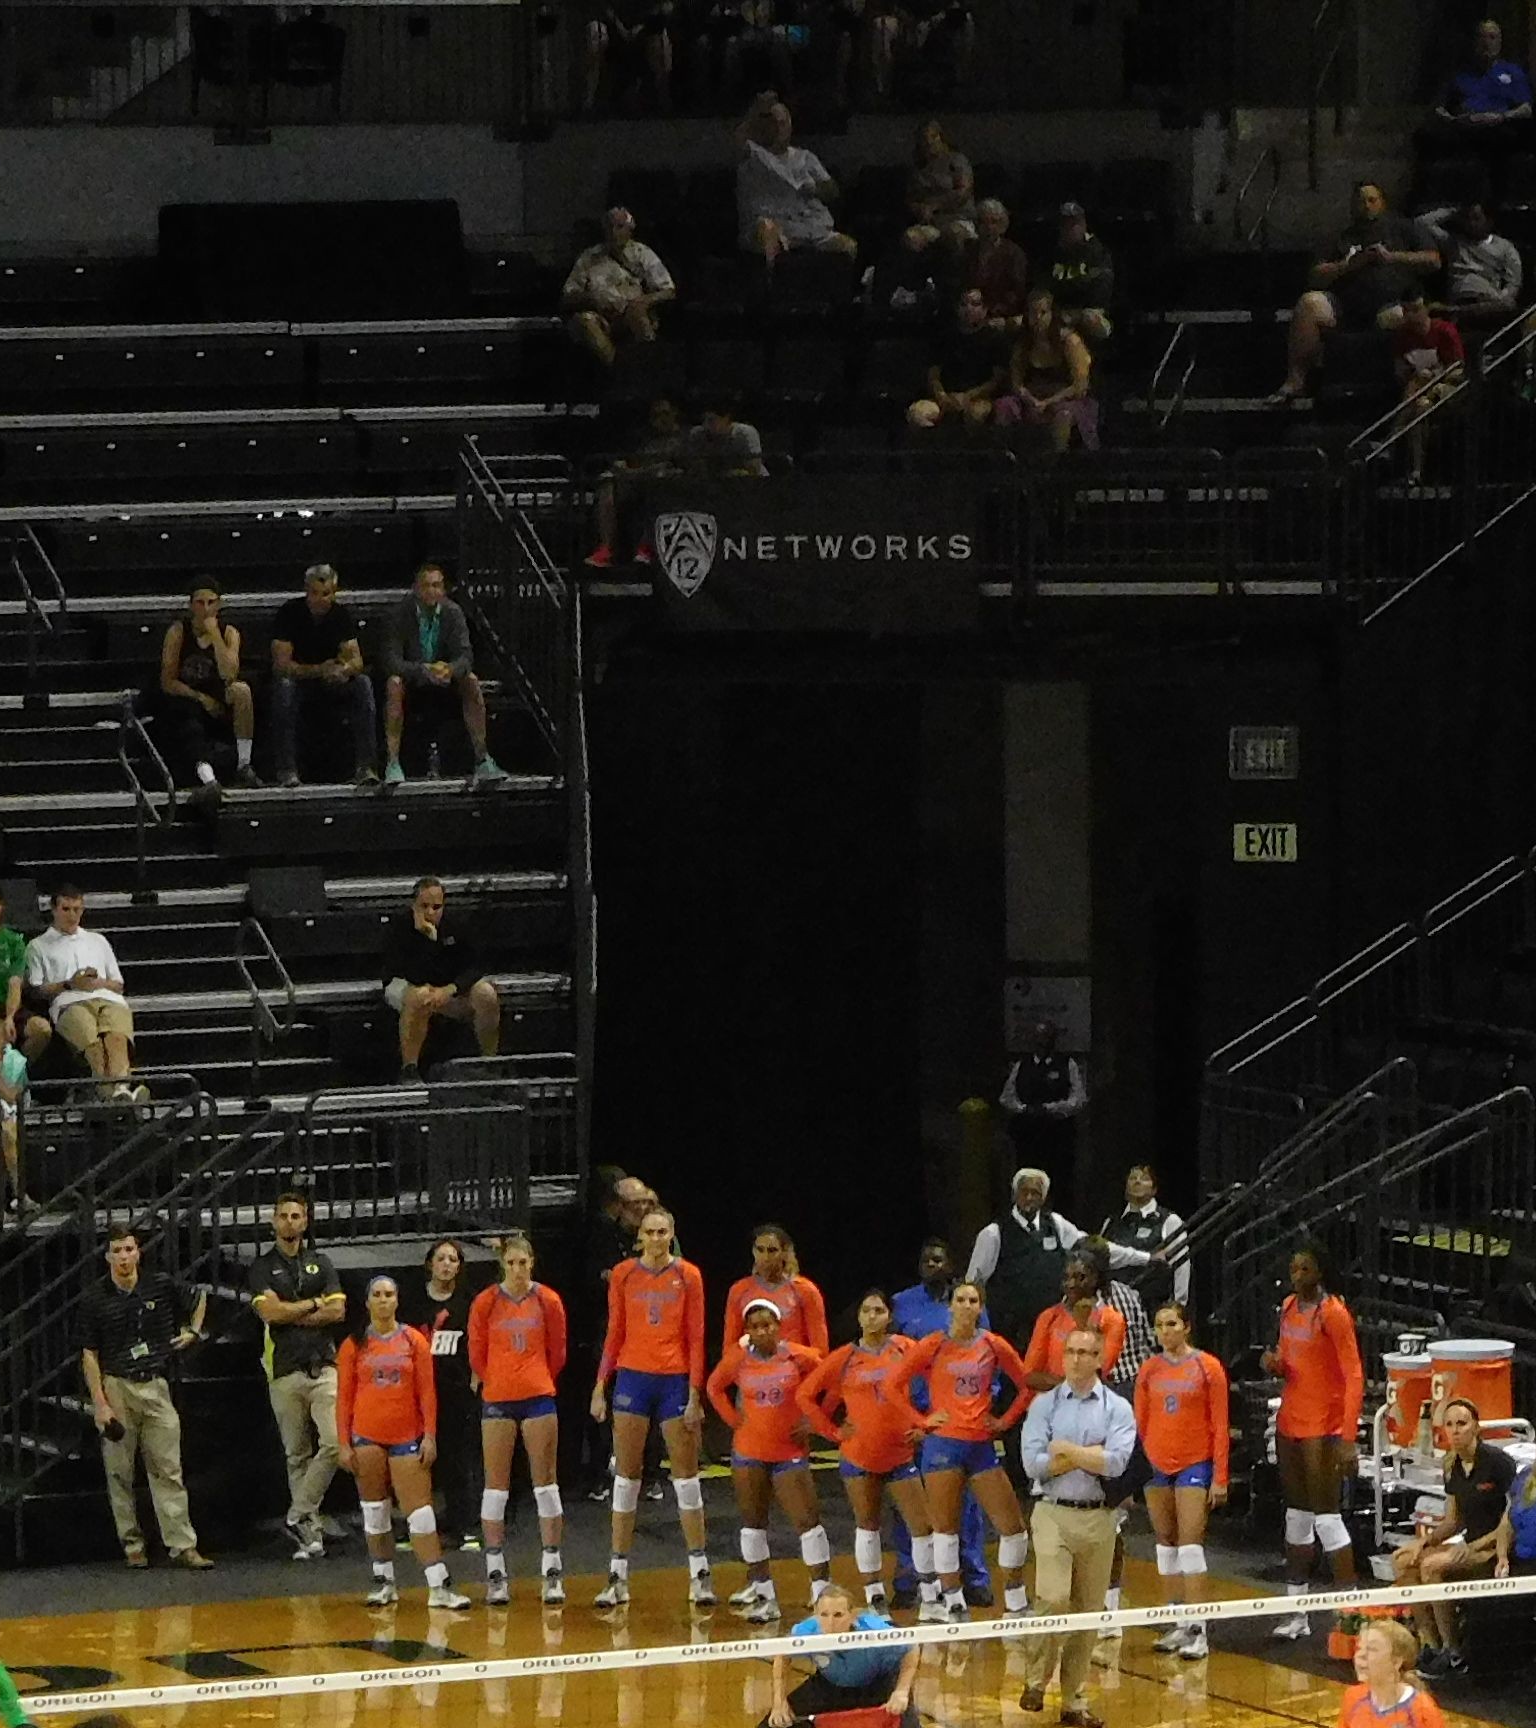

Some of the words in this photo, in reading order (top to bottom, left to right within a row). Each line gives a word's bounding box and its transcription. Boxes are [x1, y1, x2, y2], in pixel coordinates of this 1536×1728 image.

[722, 533, 972, 560] NETWORKS
[1244, 827, 1289, 857] EXIT
[33, 1692, 117, 1708] OREGON
[196, 1680, 278, 1695] OREGON
[360, 1667, 442, 1682] OREGON
[522, 1654, 602, 1670] OREGON
[681, 1641, 760, 1657] OREGON
[837, 1629, 915, 1645] OREGON
[991, 1617, 1069, 1632] OREGON
[1145, 1604, 1222, 1619] OREGON
[1295, 1591, 1371, 1607] OREGON
[1443, 1580, 1517, 1595] OREGON
